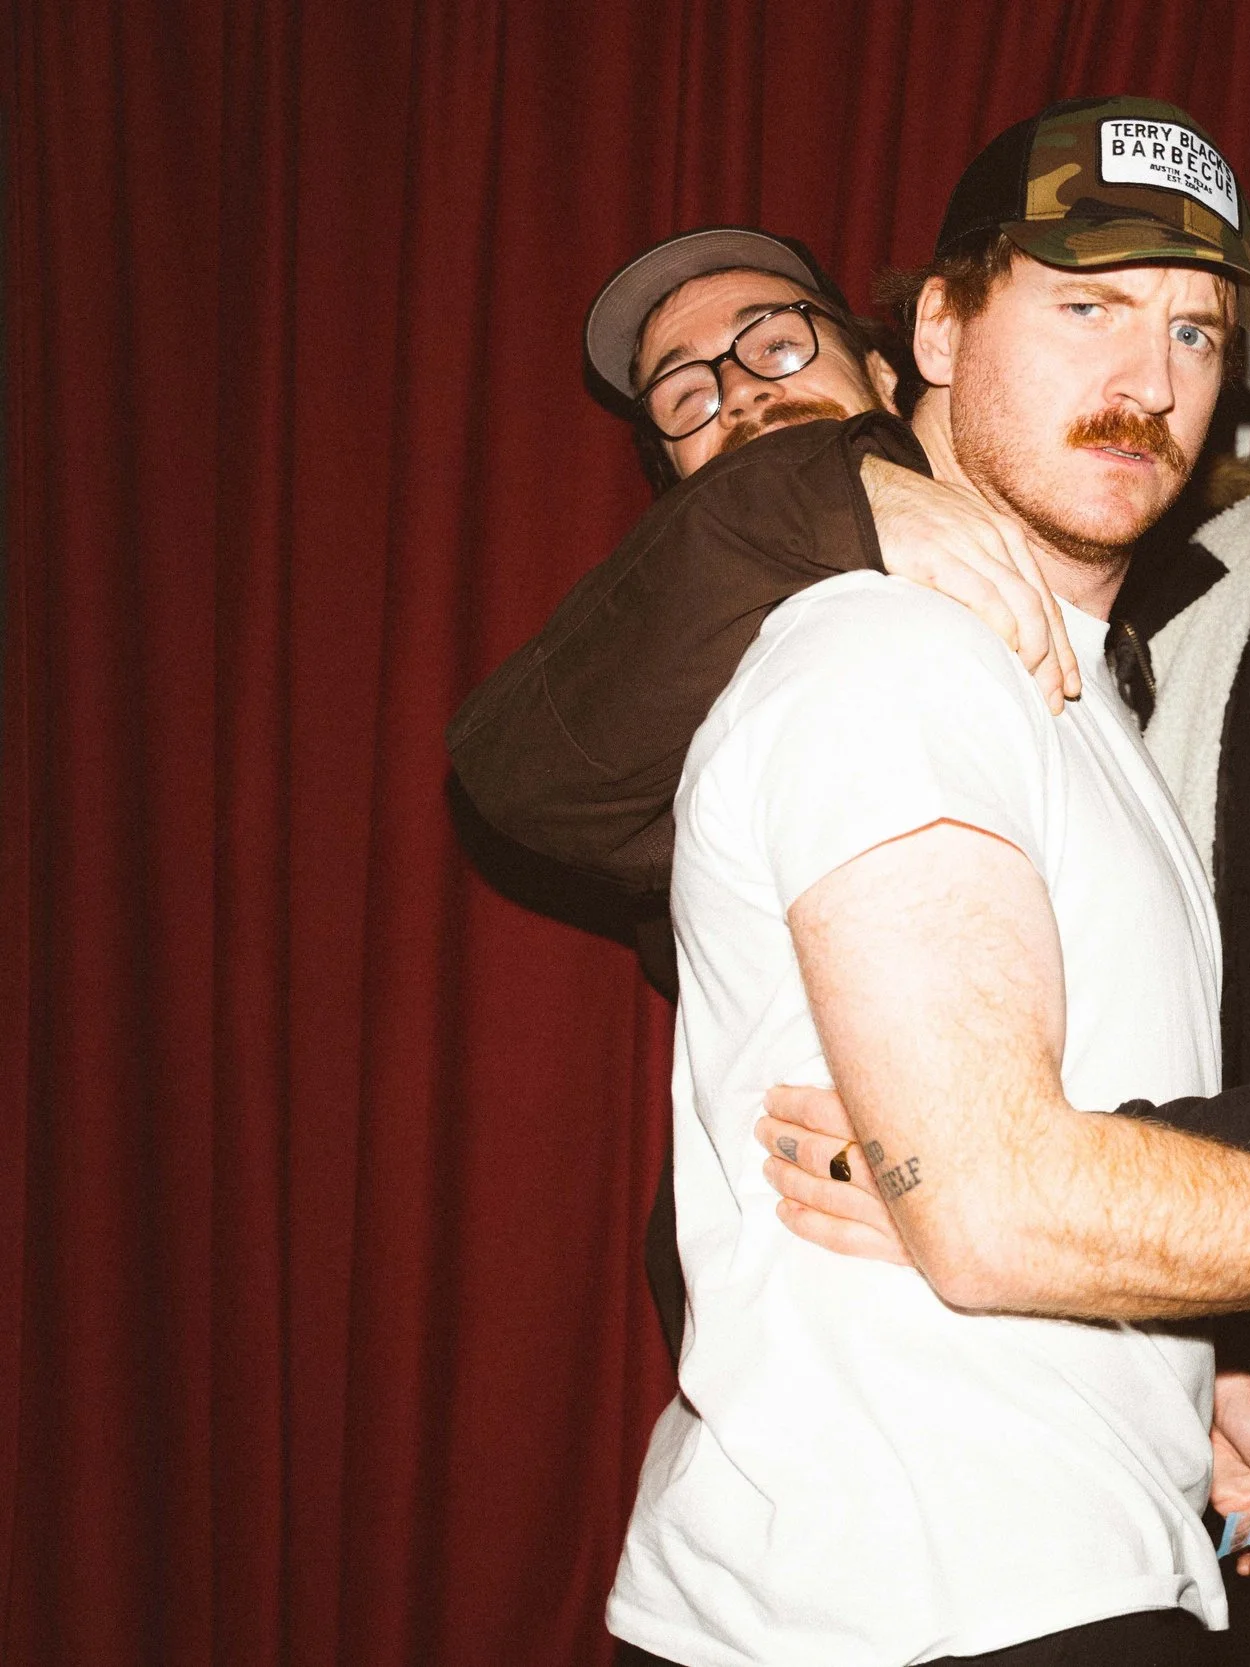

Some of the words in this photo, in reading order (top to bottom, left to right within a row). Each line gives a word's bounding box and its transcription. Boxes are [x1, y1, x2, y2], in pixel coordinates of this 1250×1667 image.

[1111, 123, 1172, 142] TERRY
[1112, 139, 1233, 202] BARBECUE
[1150, 163, 1180, 176] AUSTIN
[1193, 176, 1213, 195] TEXAS
